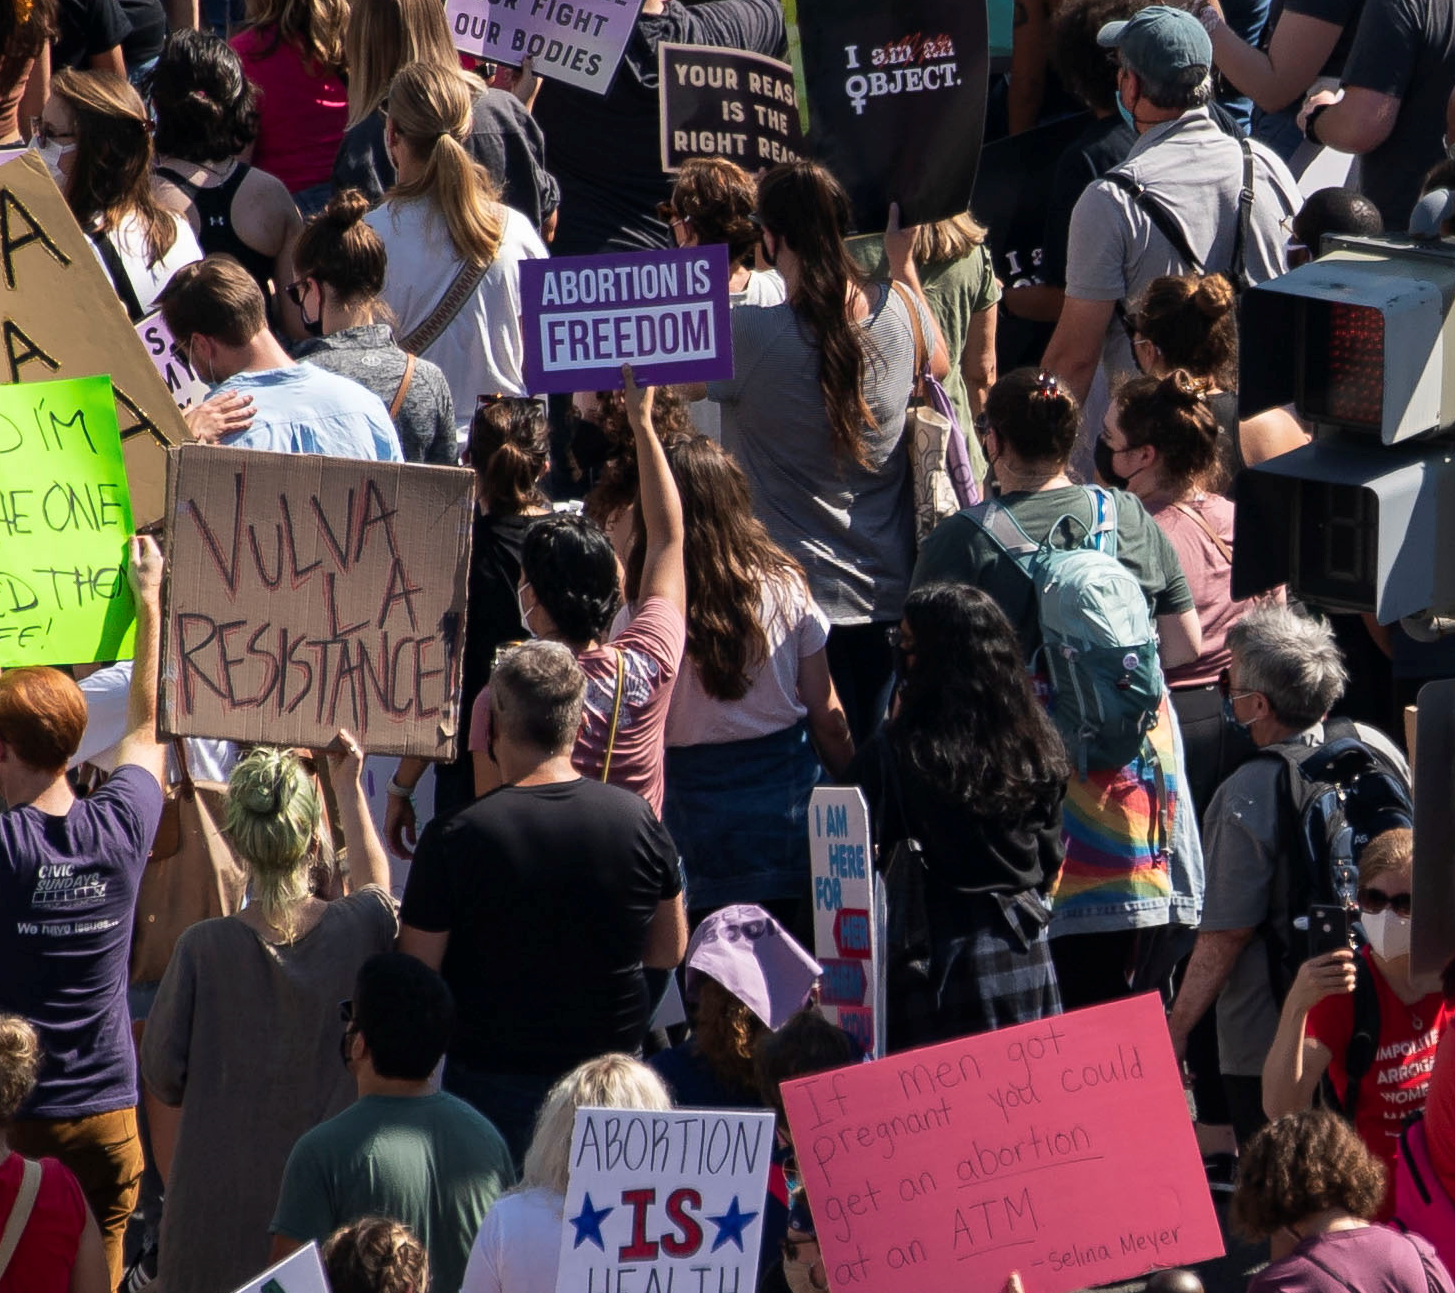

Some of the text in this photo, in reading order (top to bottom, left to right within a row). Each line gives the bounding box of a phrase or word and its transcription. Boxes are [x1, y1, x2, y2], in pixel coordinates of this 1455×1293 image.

[542, 260, 710, 305] ABORTION IS
[548, 309, 710, 362] FREEDOM
[33, 398, 97, 455] I'M
[43, 481, 121, 533] ONE
[188, 463, 397, 600] VULVA
[325, 558, 422, 636] LA
[178, 614, 460, 728] RESISTANCE!
[36, 873, 101, 891] SUNDAYS
[38, 864, 75, 878] CIVIC
[17, 923, 37, 934] We
[42, 923, 71, 934] have
[574, 1116, 763, 1174] ABORTION
[618, 1188, 704, 1260] IS
